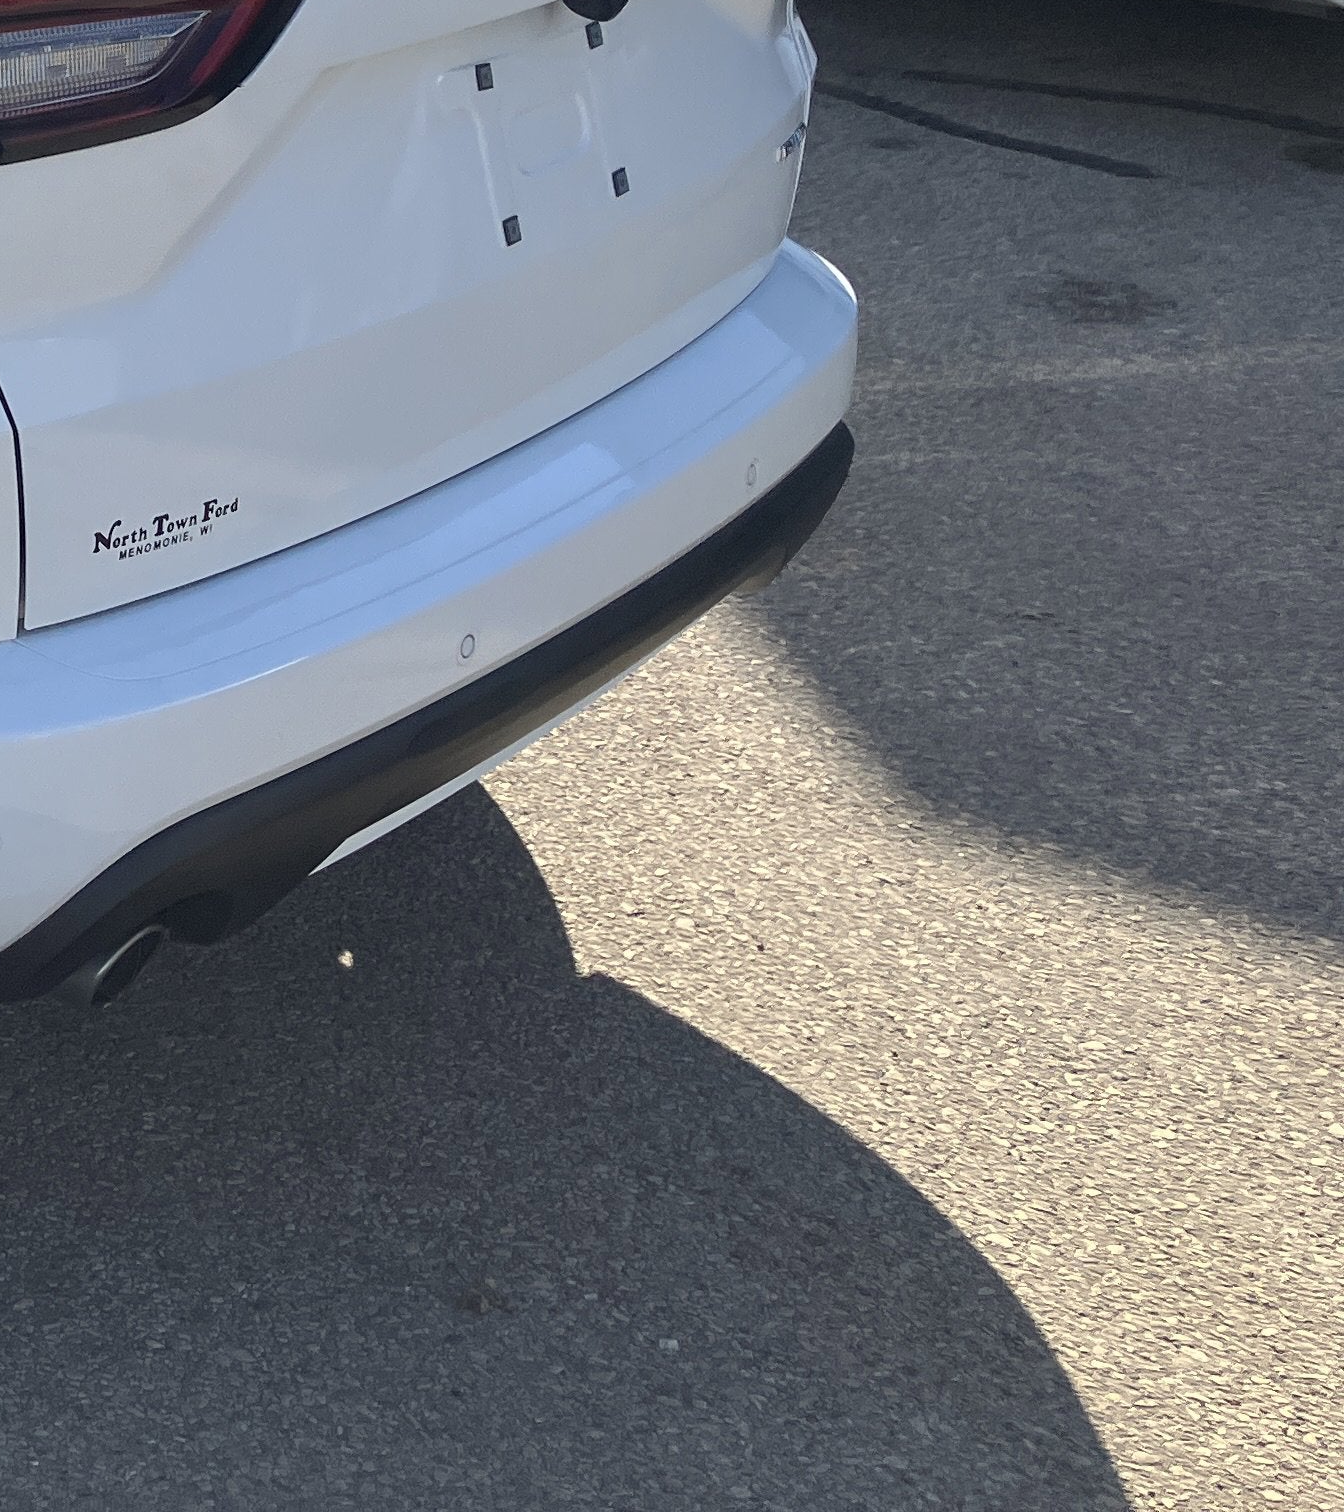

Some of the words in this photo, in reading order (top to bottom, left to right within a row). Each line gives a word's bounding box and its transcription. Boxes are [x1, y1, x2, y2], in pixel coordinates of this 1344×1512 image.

[93, 519, 148, 553] North
[152, 513, 197, 537] Town
[201, 497, 239, 523] Ford
[200, 524, 213, 536] WI
